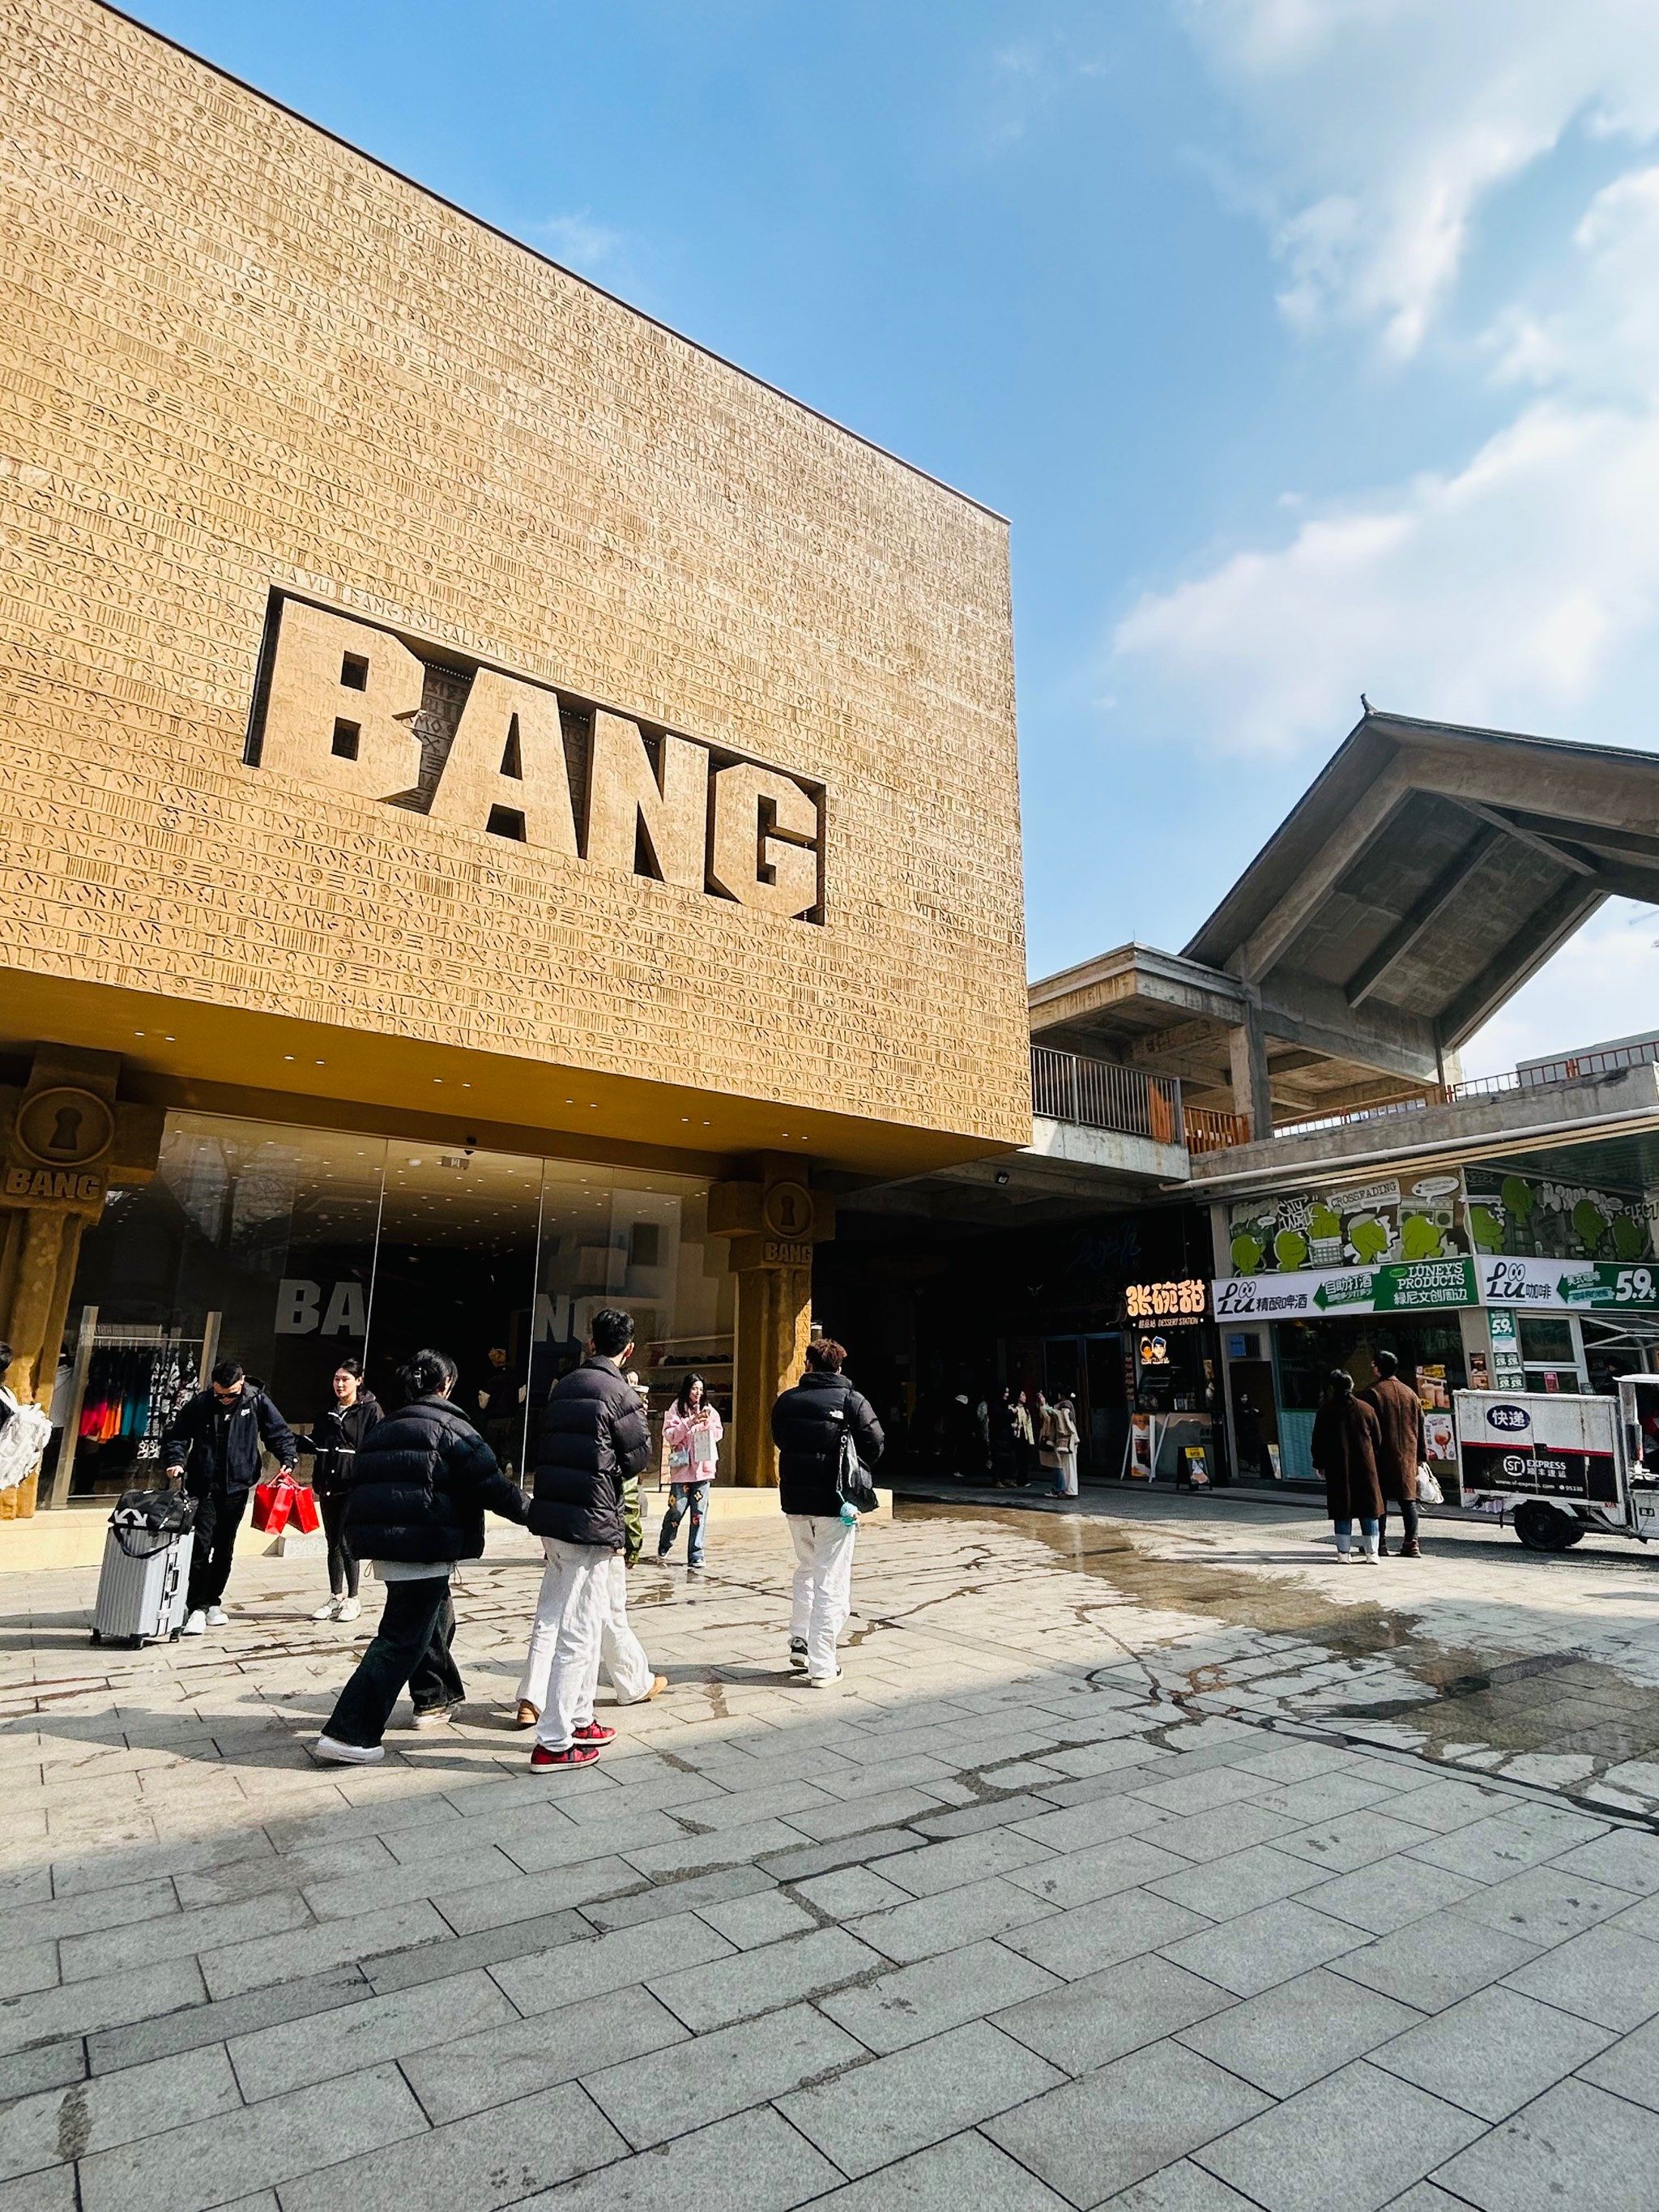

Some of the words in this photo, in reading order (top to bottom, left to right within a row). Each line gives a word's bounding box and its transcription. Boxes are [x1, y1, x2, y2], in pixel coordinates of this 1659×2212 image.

[260, 595, 818, 920] BANG
[6, 1168, 101, 1200] BANG
[764, 1242, 812, 1263] BANG
[1325, 1273, 1372, 1295] 自助打酒
[1397, 1274, 1465, 1290] PRODUCTS
[1525, 1283, 1552, 1300] 咖啡
[1126, 1279, 1205, 1317] 张碗甜
[1256, 1294, 1308, 1312] 精酿啤酒
[274, 1279, 366, 1337] BA
[1158, 1317, 1178, 1327] DESSERT
[1179, 1317, 1198, 1326] STATION
[1492, 1410, 1526, 1427] 快递
[1526, 1459, 1567, 1471] EXPRESS
